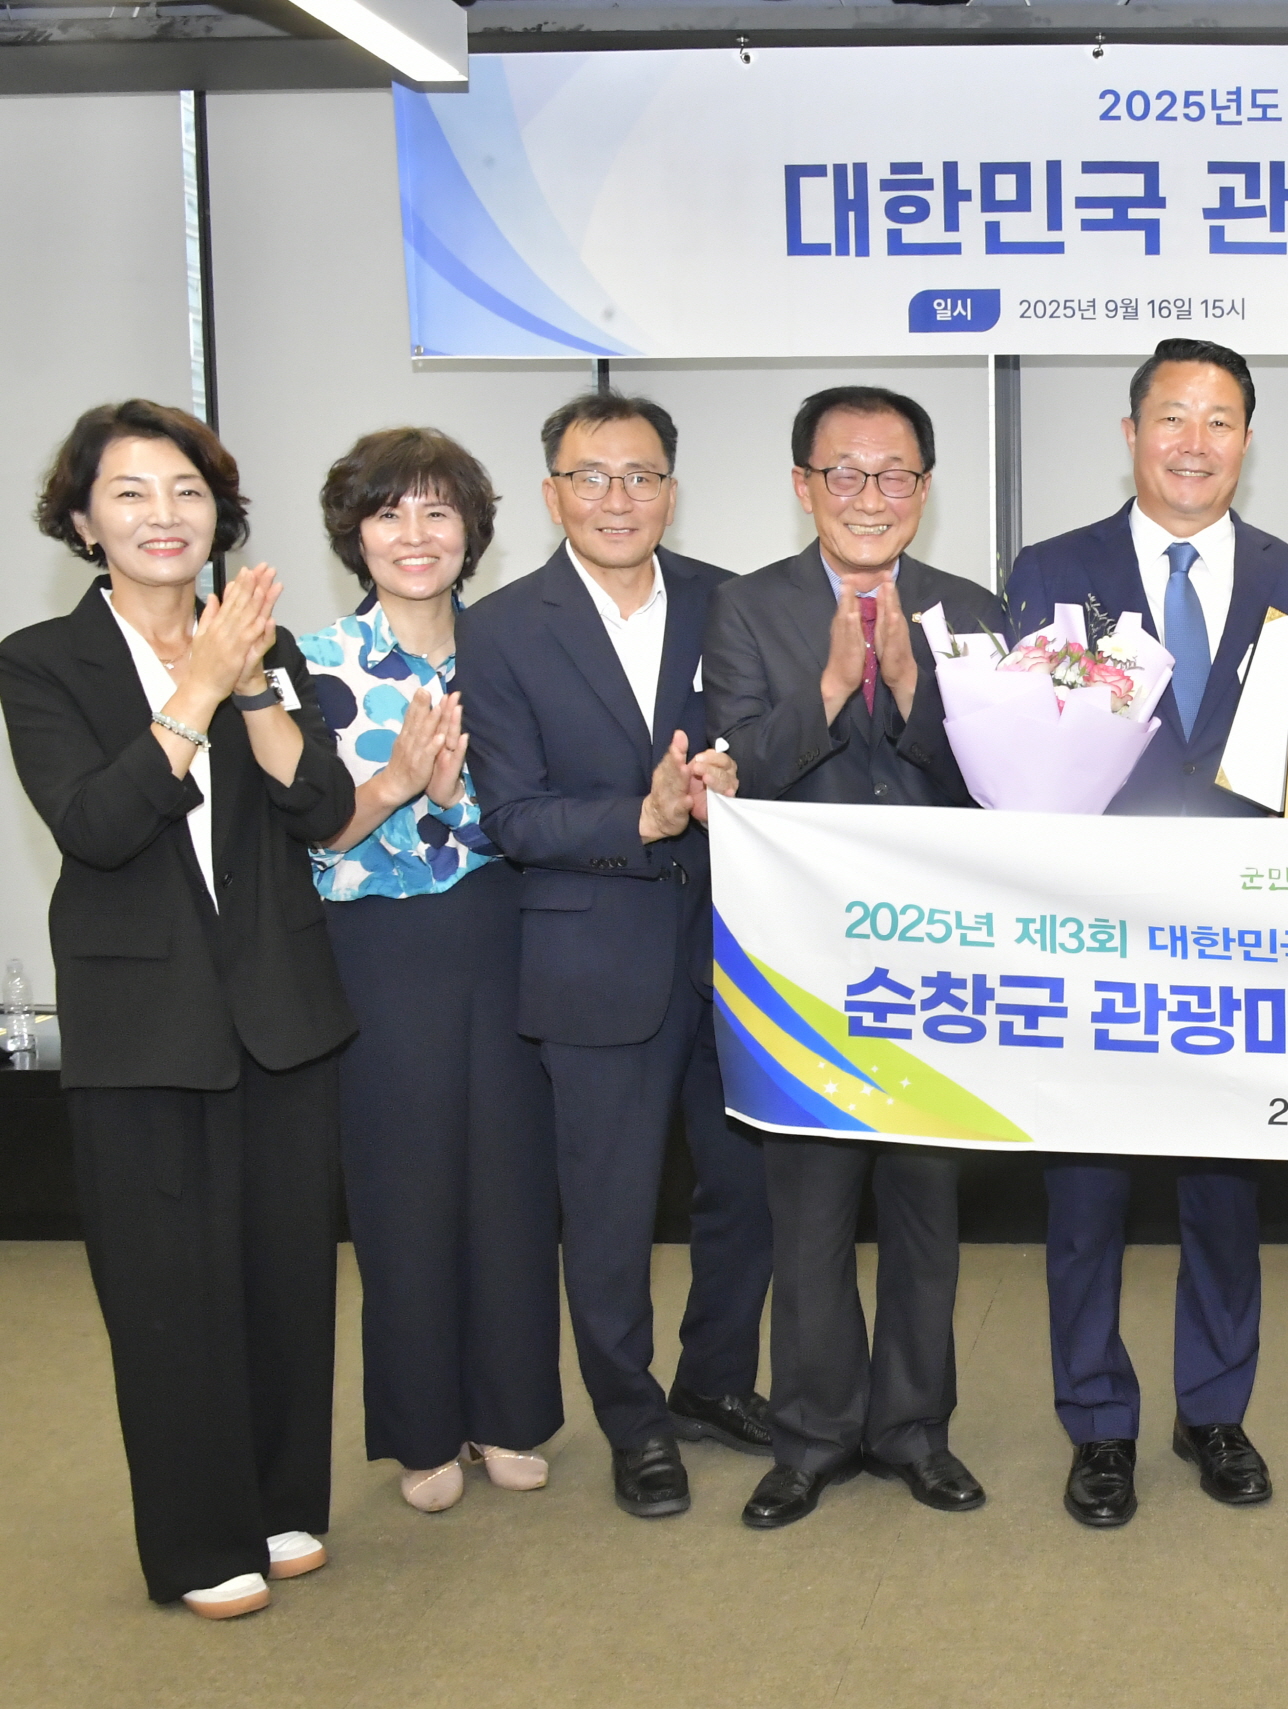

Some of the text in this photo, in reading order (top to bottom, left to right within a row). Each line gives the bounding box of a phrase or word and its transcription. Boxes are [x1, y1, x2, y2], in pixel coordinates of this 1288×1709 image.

[1099, 86, 1282, 126] 2025년도
[784, 160, 1166, 257] 대한민국
[933, 298, 971, 320] 일시
[1019, 298, 1244, 320] 2025년 9월 16일 15시
[845, 901, 994, 947] 2025년
[1015, 915, 1127, 958] 제3회
[844, 966, 1068, 1049] 순창군
